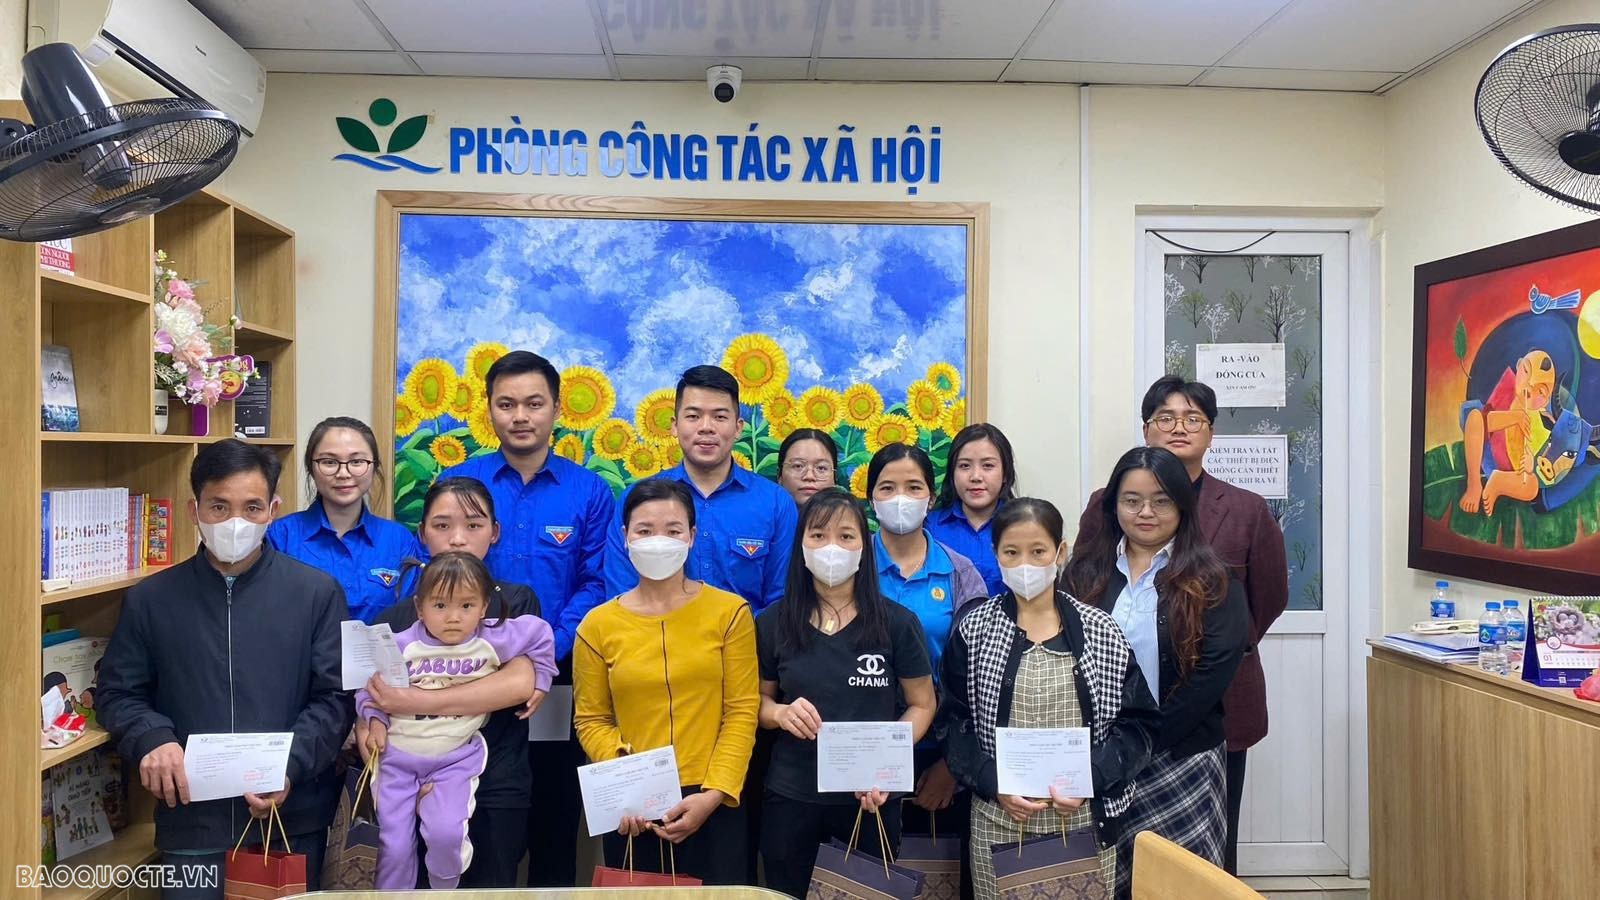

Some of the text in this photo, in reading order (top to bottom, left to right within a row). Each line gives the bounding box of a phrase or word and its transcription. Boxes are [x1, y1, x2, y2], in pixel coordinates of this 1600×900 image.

[449, 116, 942, 196] PHÒNG CÔNG TÁC XÃ HỘI
[1221, 355, 1235, 363] RA
[1249, 446, 1261, 454] VÀ
[1207, 466, 1236, 474] KHÔNG
